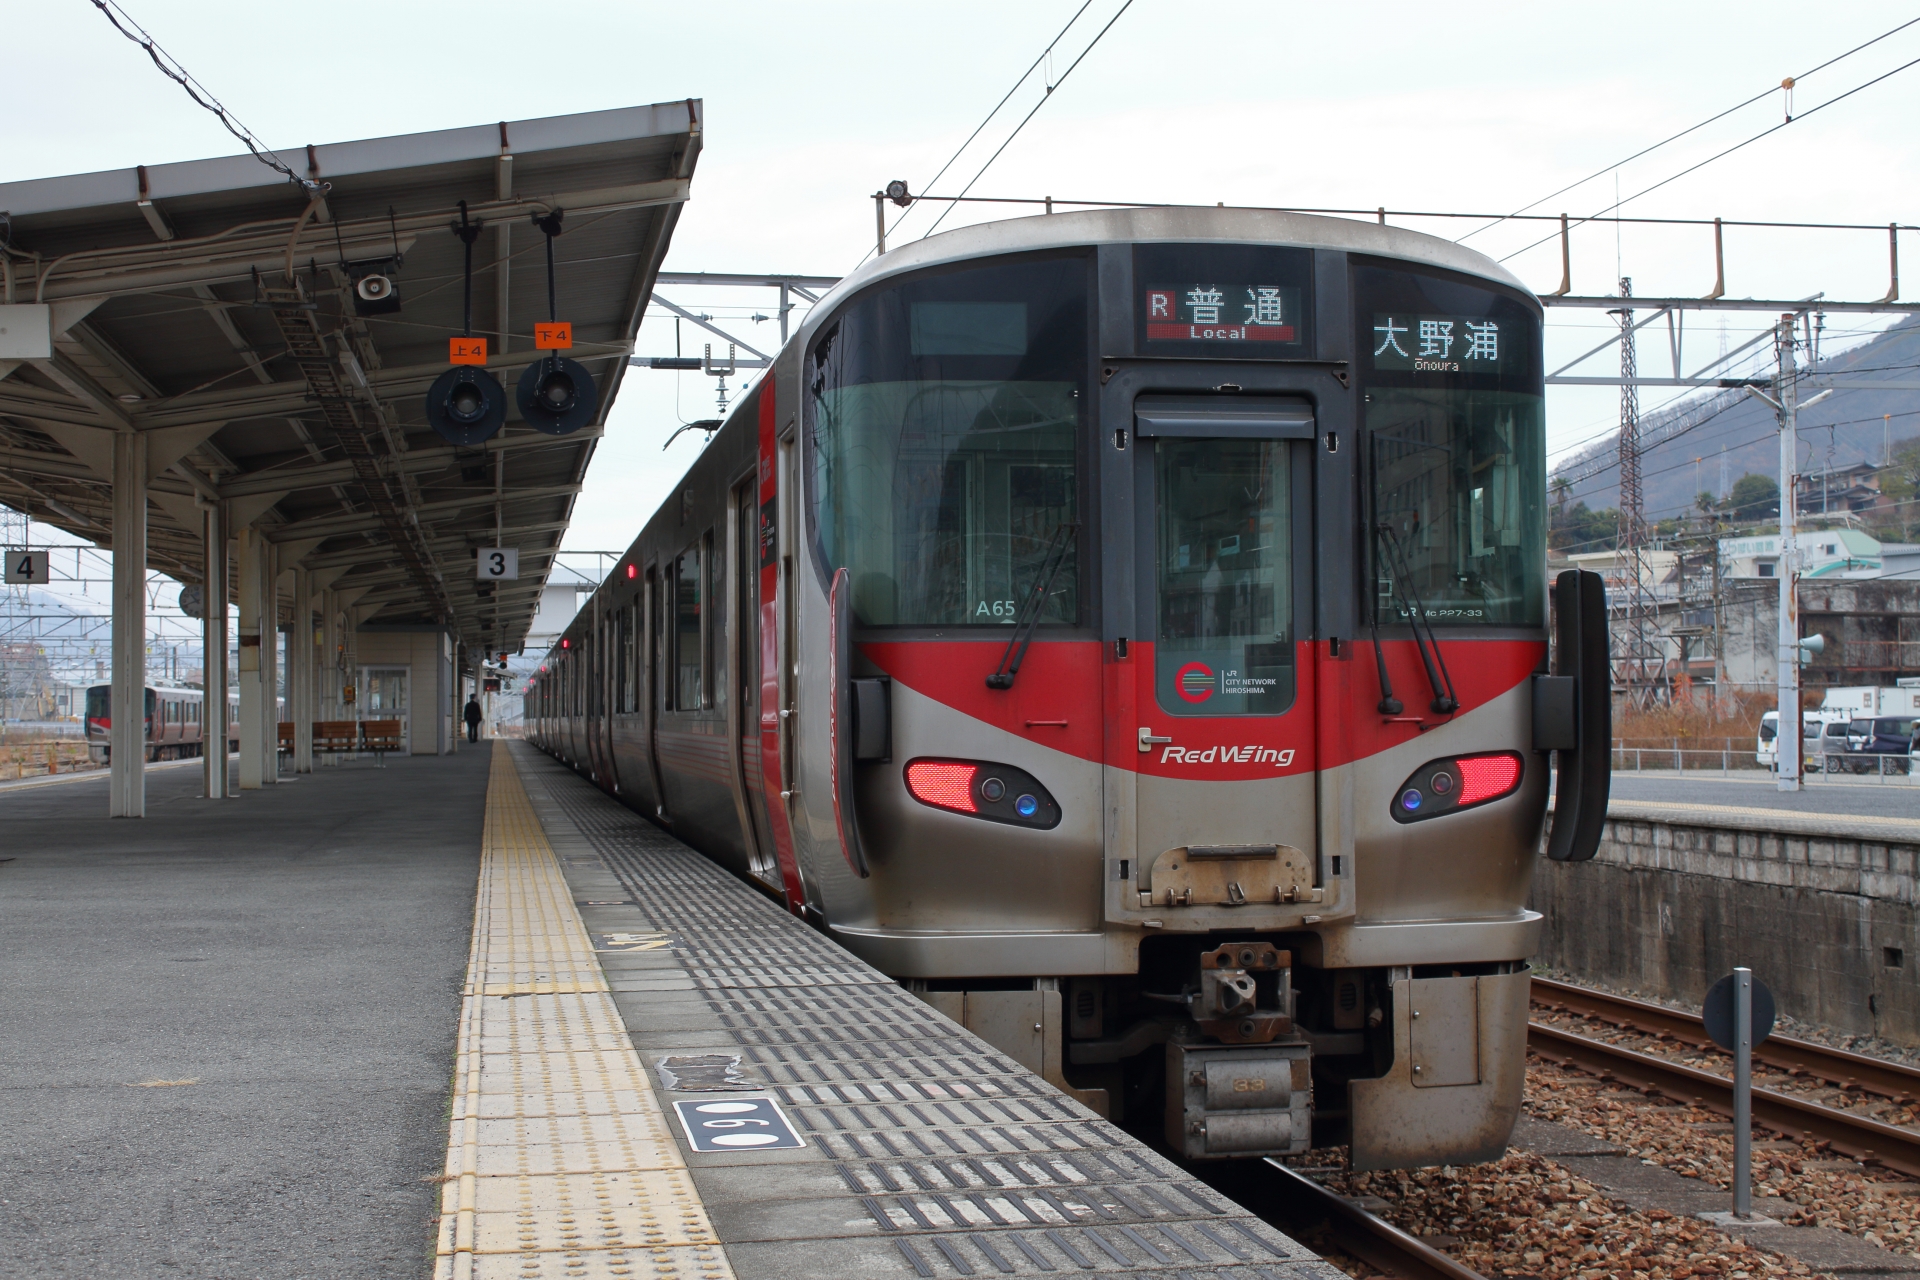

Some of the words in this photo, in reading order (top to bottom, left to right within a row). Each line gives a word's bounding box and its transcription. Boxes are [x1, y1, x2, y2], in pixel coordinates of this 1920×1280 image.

[1151, 293, 1168, 317] R
[1185, 283, 1283, 326] 普通
[1190, 325, 1246, 340] Local
[1373, 317, 1499, 361] 大野浦
[17, 556, 34, 578] 4
[489, 553, 505, 576] 3
[975, 600, 1016, 617] A65
[1439, 609, 1483, 617] 227-33
[1233, 1079, 1265, 1092] 33
